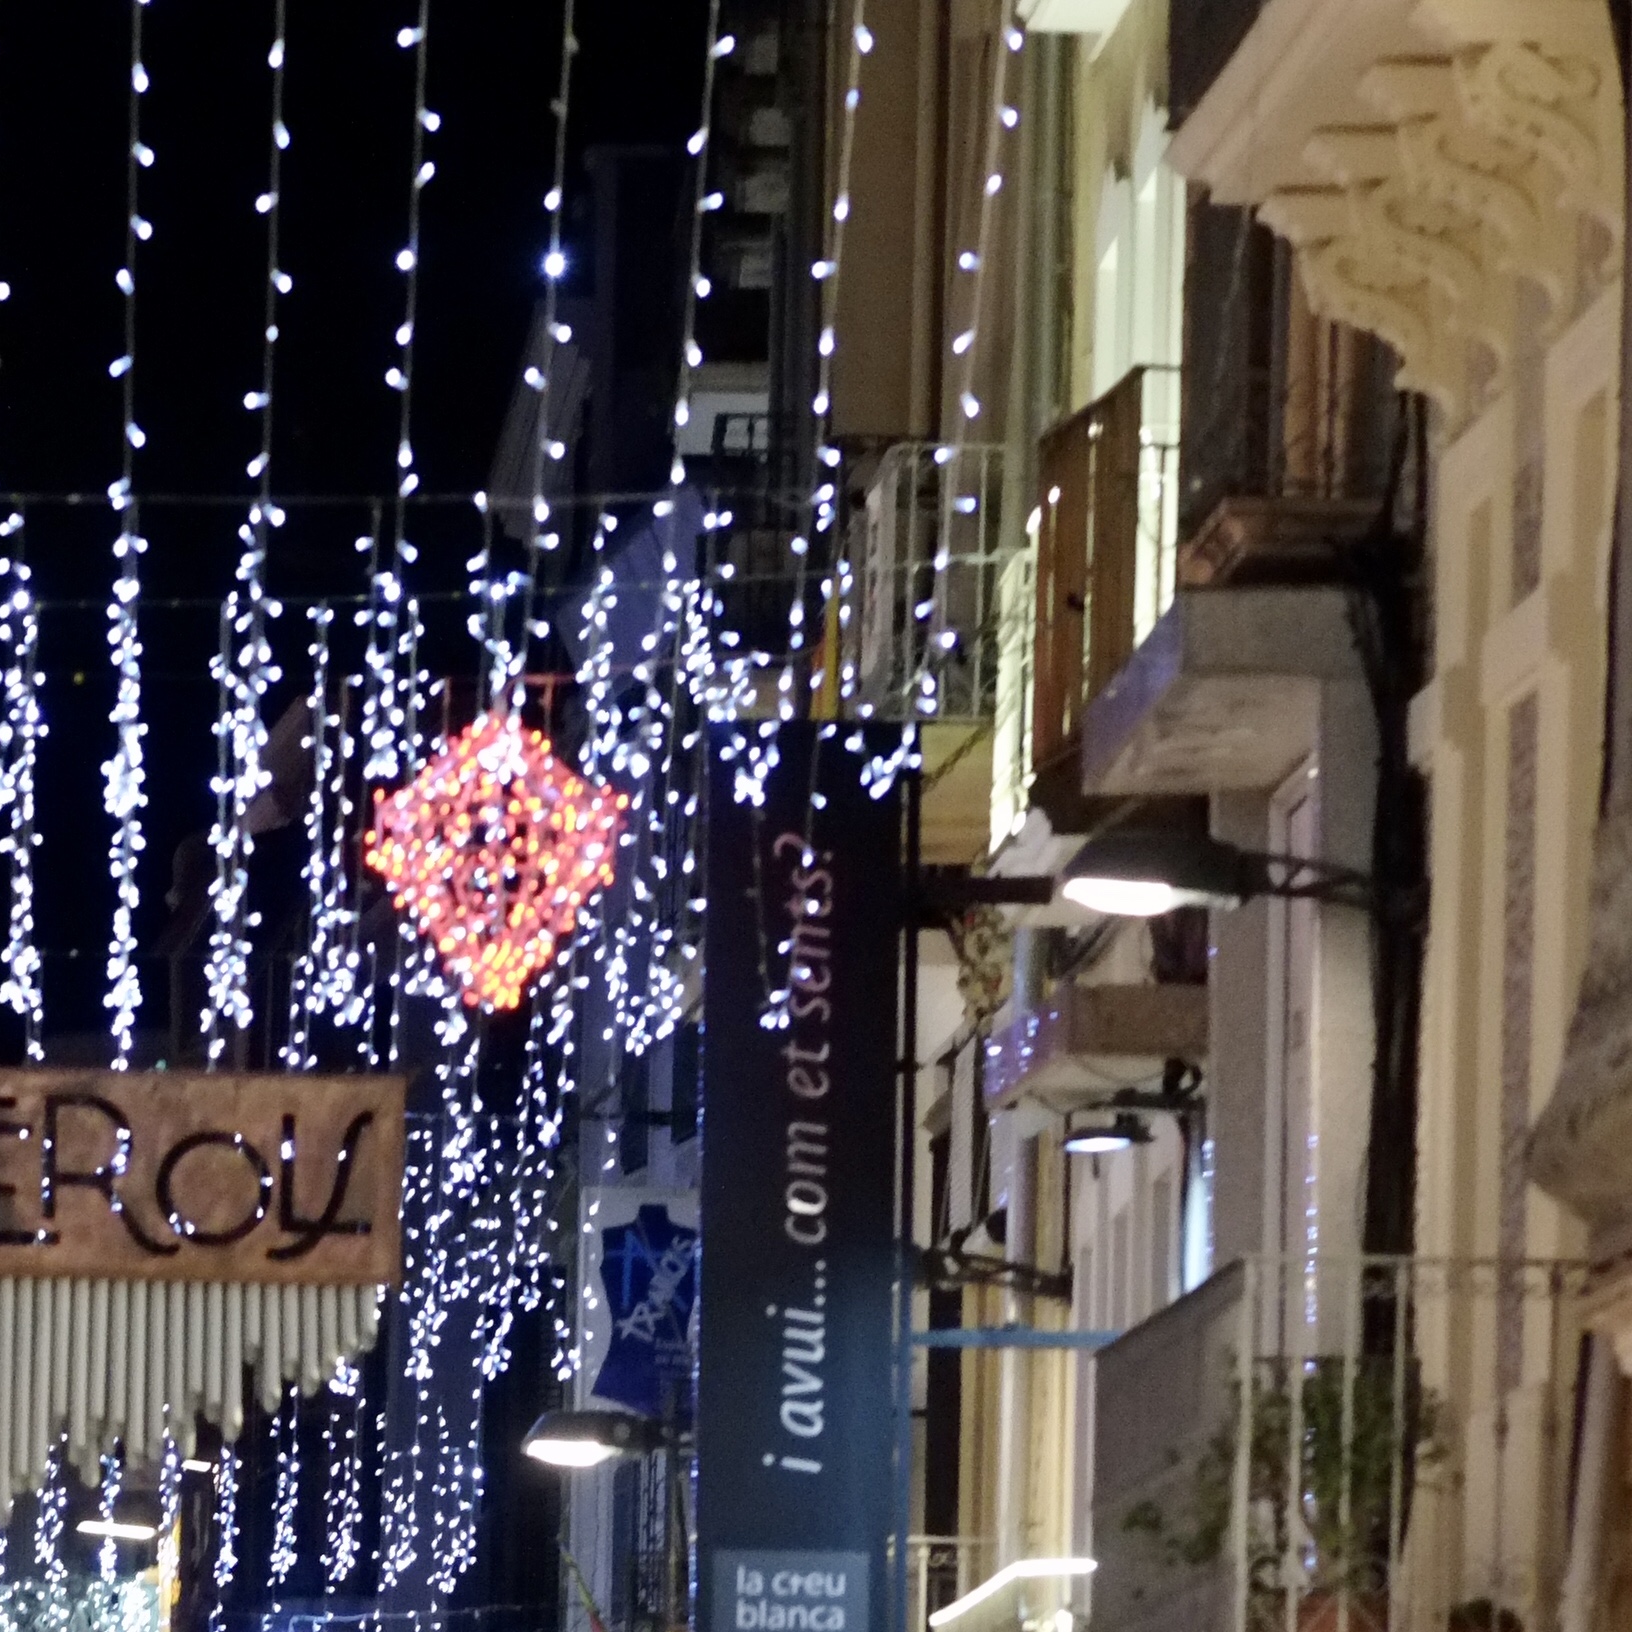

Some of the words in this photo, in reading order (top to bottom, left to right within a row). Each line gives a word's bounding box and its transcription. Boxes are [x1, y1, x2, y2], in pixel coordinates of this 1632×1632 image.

[782, 1040, 830, 1099] et
[784, 1121, 827, 1244] com
[765, 1258, 827, 1438] avui...
[762, 1453, 823, 1474] i
[737, 1565, 764, 1596] la
[771, 1570, 847, 1597] creu
[736, 1598, 845, 1631] blanca
